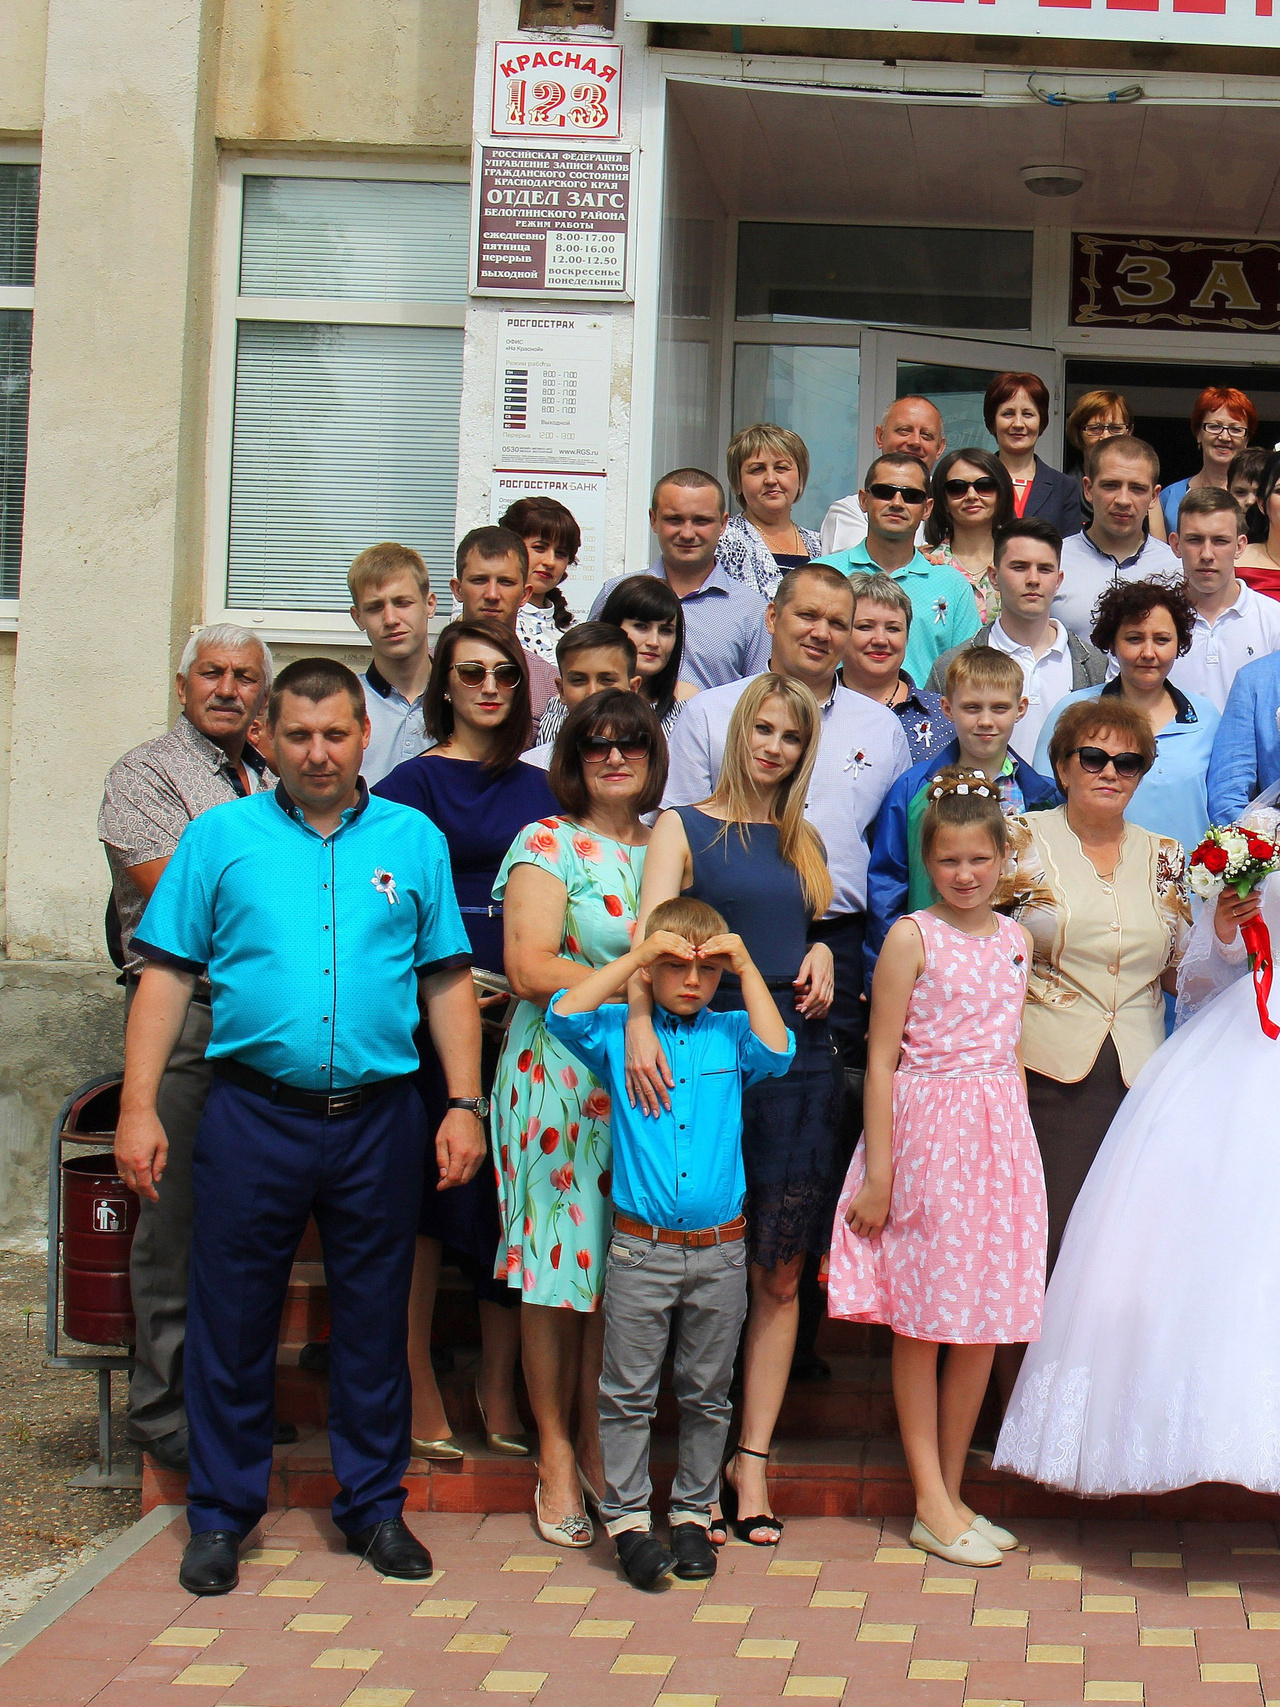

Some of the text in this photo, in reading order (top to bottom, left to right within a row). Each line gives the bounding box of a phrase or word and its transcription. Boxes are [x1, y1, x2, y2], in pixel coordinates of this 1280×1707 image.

[500, 51, 618, 83] КРАСНАЯ
[505, 79, 609, 129] 123
[492, 150, 623, 163] РОССИЙСКАЯ ФЕДЕРАЦИЯ
[485, 159, 629, 172] УПРАВЛЕНИЕ ЗАПИСИ АКТОВ
[484, 168, 629, 181] ГРАЖДАНСКОГО СОСТОЯНИЯ
[494, 178, 618, 190] КРАСНОДАРСКОГО КРАЯ
[486, 189, 625, 209] ОТДЕЛ ЗАГС
[484, 208, 626, 221] БЕЛОГЛИНСКОГО РАЙОНА
[515, 220, 594, 229] РЕЖИМ РАБОТЫ
[483, 232, 616, 242] ежедневно 8.00-17.00
[482, 243, 615, 254] пятница 8.00-16.00
[482, 254, 617, 265] перерыв 12.00-12.50
[480, 267, 621, 280] выходной воскресенье
[548, 277, 621, 287] понедельник
[507, 319, 575, 329] РОСГОССТРАХ
[500, 480, 598, 491] РОСГОССТРАХ БАНК
